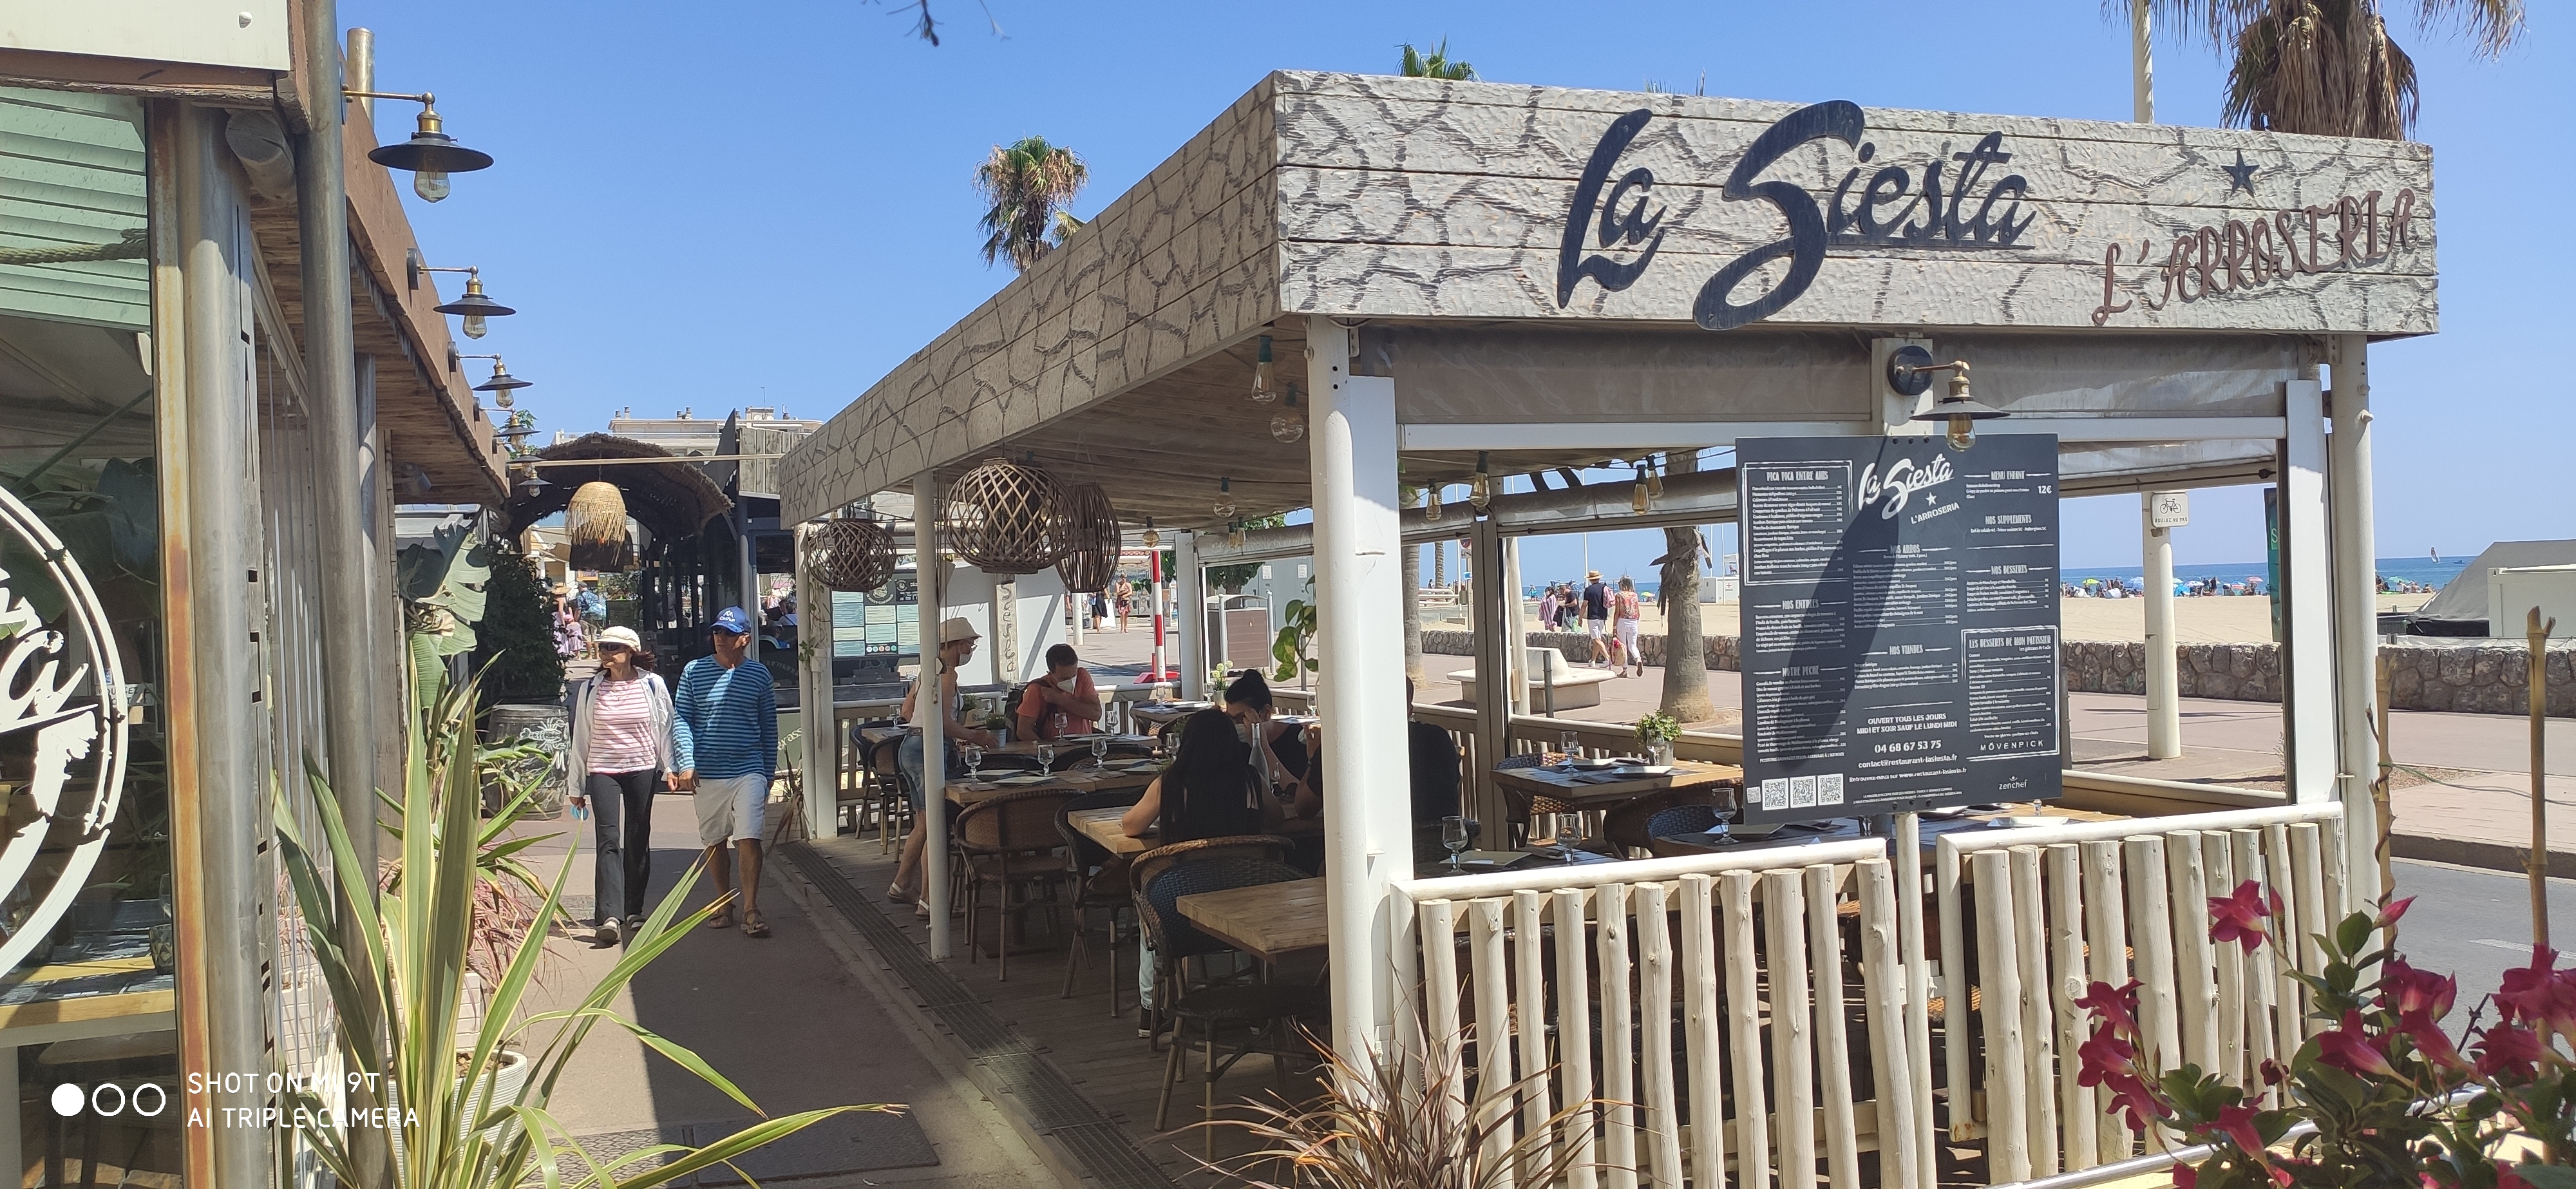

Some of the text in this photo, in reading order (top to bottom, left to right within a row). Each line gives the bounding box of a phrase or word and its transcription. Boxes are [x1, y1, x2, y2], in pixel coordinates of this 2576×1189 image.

[1557, 99, 2037, 330] La Siesta
[2092, 187, 2417, 326] L'ARROSERIA
[1991, 471, 2005, 480] MENU
[1858, 453, 1955, 520] La Siesta
[2038, 485, 2052, 494] 12€
[1910, 502, 1960, 524] L'ARROSERIA
[1985, 515, 1996, 525] NOS
[1991, 565, 2027, 575] NOS DESSERTS
[1783, 600, 1794, 610] NOS
[1969, 639, 1978, 649] LES
[1980, 638, 2004, 648] DESSERTS
[2005, 638, 2012, 646] DE
[1889, 645, 1900, 656] NOS
[1895, 715, 1912, 723] TOUS
[1875, 739, 1942, 753] 04 68 67 53 75
[1859, 754, 1958, 768] contact@restaurant-lasiesta.fr
[1999, 779, 2028, 790] zenchef
